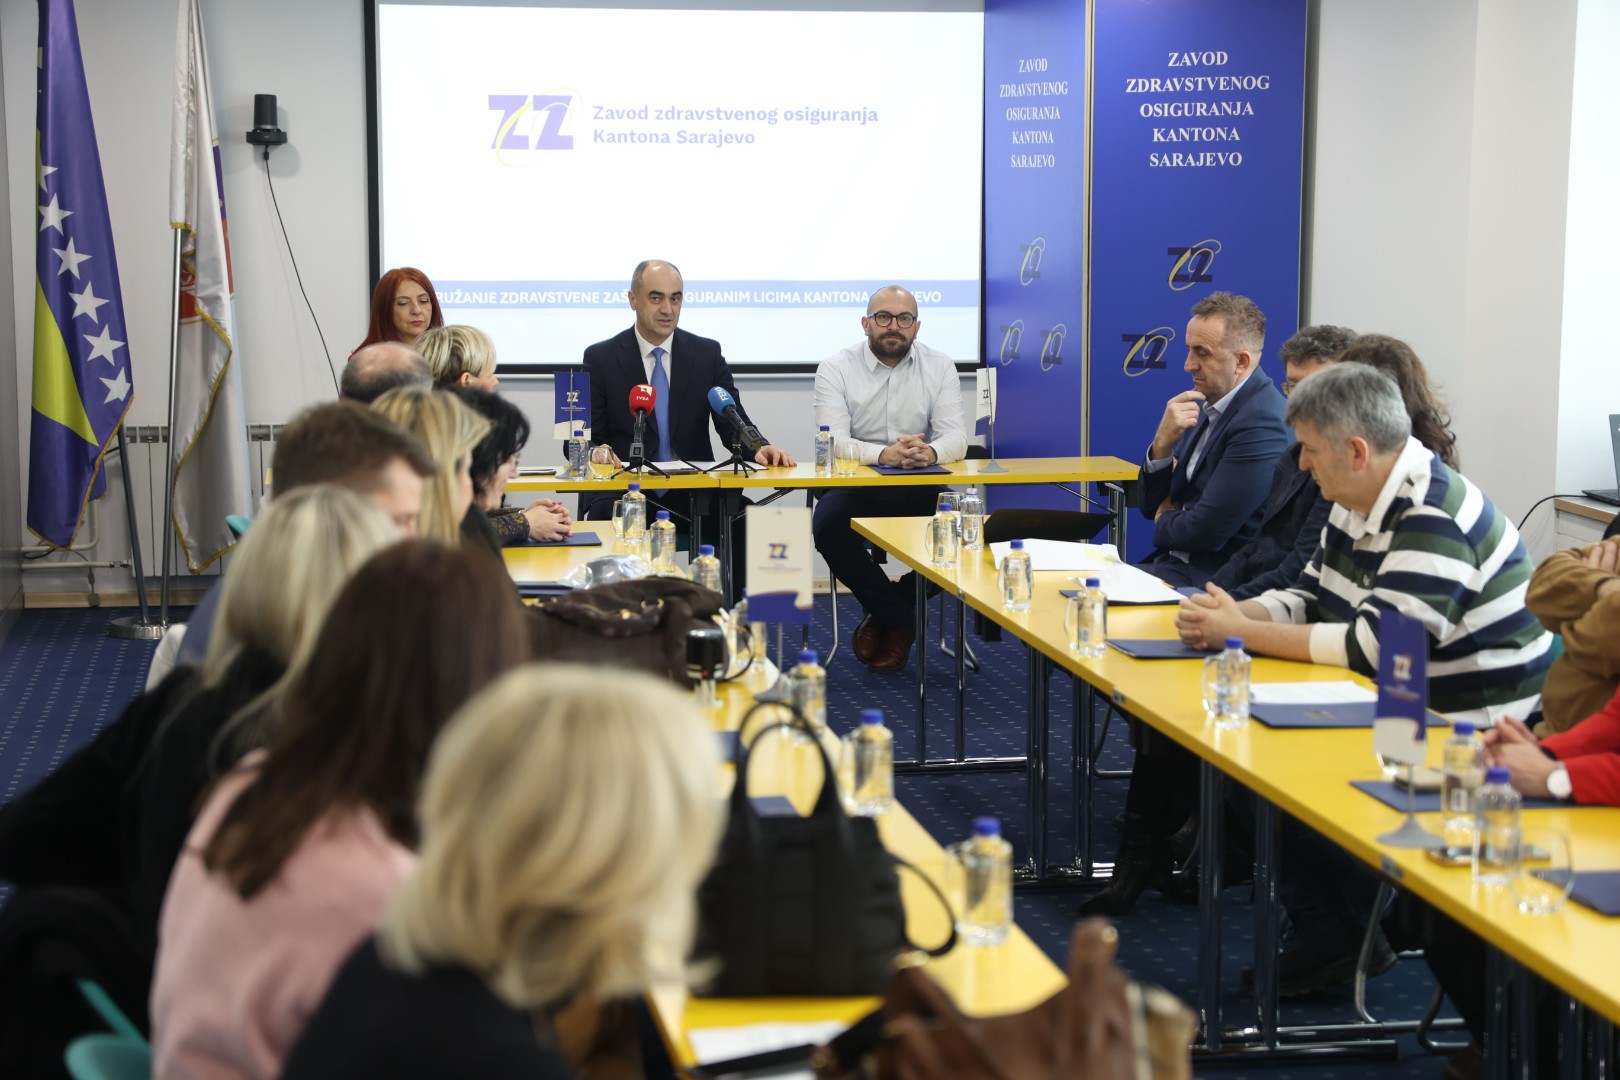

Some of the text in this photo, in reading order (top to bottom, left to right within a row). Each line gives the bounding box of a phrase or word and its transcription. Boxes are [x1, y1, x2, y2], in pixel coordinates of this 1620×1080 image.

[1018, 58, 1048, 73] ZAVOD
[1167, 51, 1228, 67] ZAVOD
[999, 81, 1068, 98] ZDRAVSTVENOG
[1125, 75, 1271, 93] ZDRAVSTVENOG
[592, 105, 879, 126] Zavod zdravstvenog osiguranja
[1006, 106, 1061, 121] OSIGURANJA
[1139, 101, 1255, 118] OSIGURANJA
[593, 129, 756, 149] Kantona Sarajevo
[1012, 130, 1054, 145] KANTONA
[1152, 126, 1241, 143] KANTONA
[1010, 154, 1056, 169] SARAJEVO
[1150, 152, 1243, 167] SARAJEVO
[436, 288, 497, 304] RUŽANJE
[500, 291, 600, 304] ZDRAVSTVENE
[684, 291, 751, 304] GURANIM
[753, 291, 801, 304] LICIMA
[804, 291, 869, 304] KANTONA
